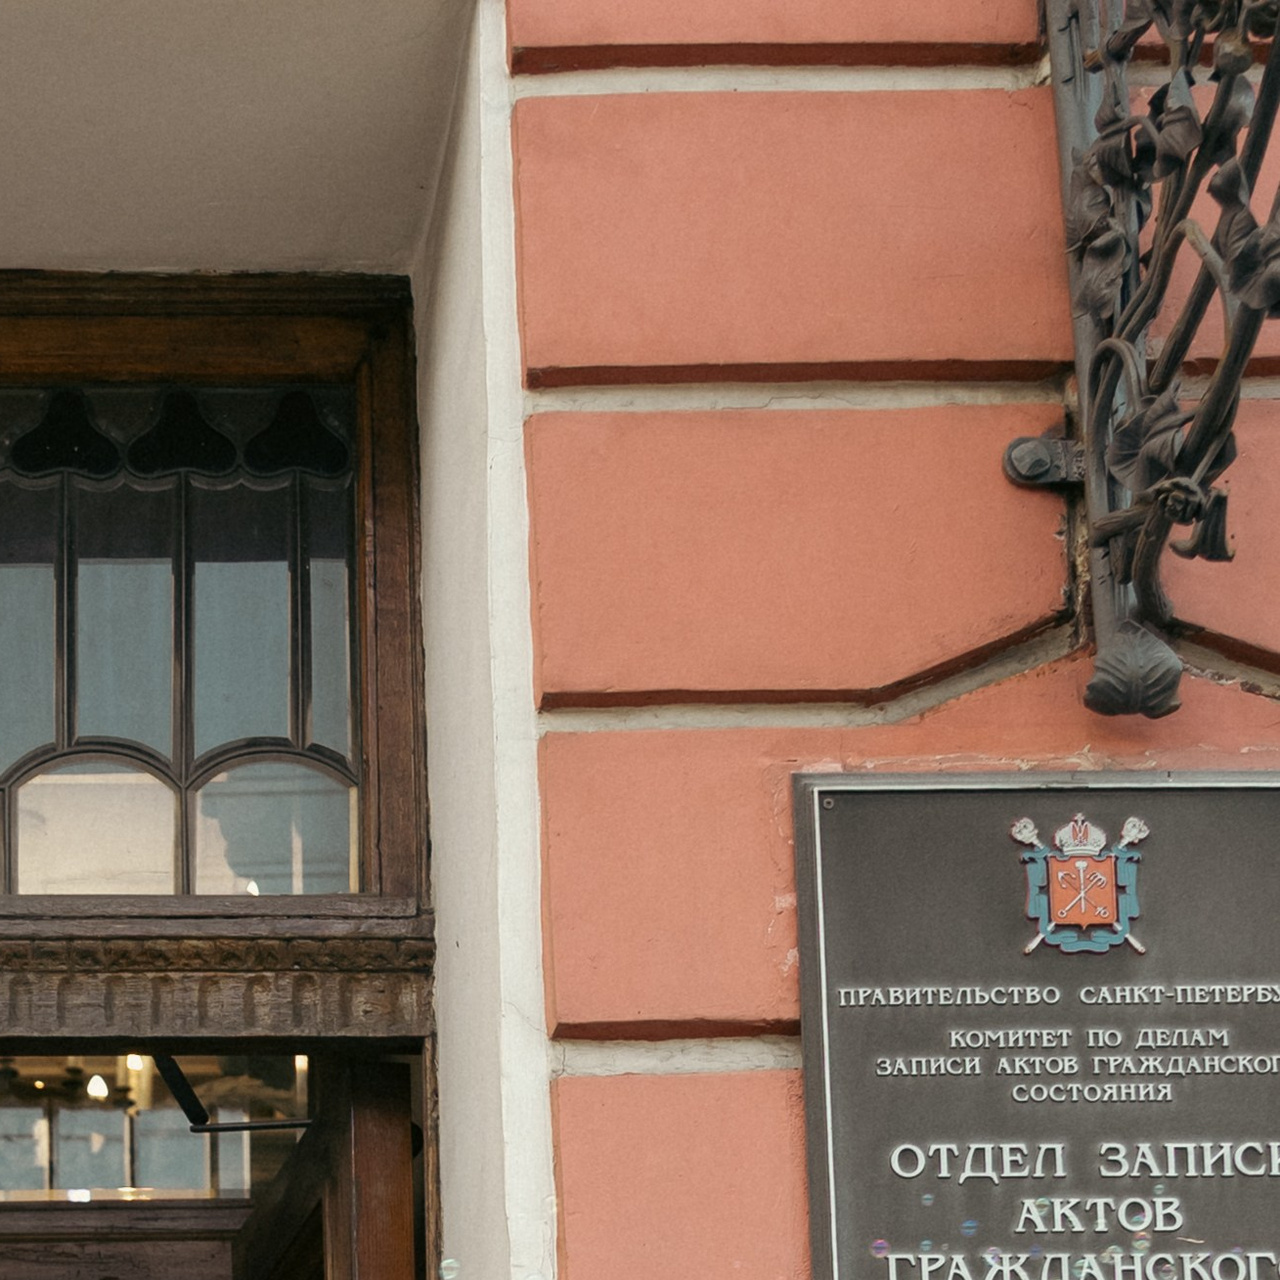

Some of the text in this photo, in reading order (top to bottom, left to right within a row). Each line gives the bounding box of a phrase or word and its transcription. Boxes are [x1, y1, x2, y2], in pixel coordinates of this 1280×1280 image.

[838, 986, 1061, 1006] ПРАВИТЕЛЬСТВО
[950, 1028, 1230, 1050] КОМИТЕТ ПО ДЕЛАМ
[876, 1057, 982, 1076] ЗАПИСИ
[997, 1056, 1079, 1075] АКТОВ
[1012, 1084, 1173, 1102] СОСТОЯНИЯ
[890, 1143, 1068, 1184] ОТДЕЛ
[1015, 1198, 1184, 1232] АКТОВ
